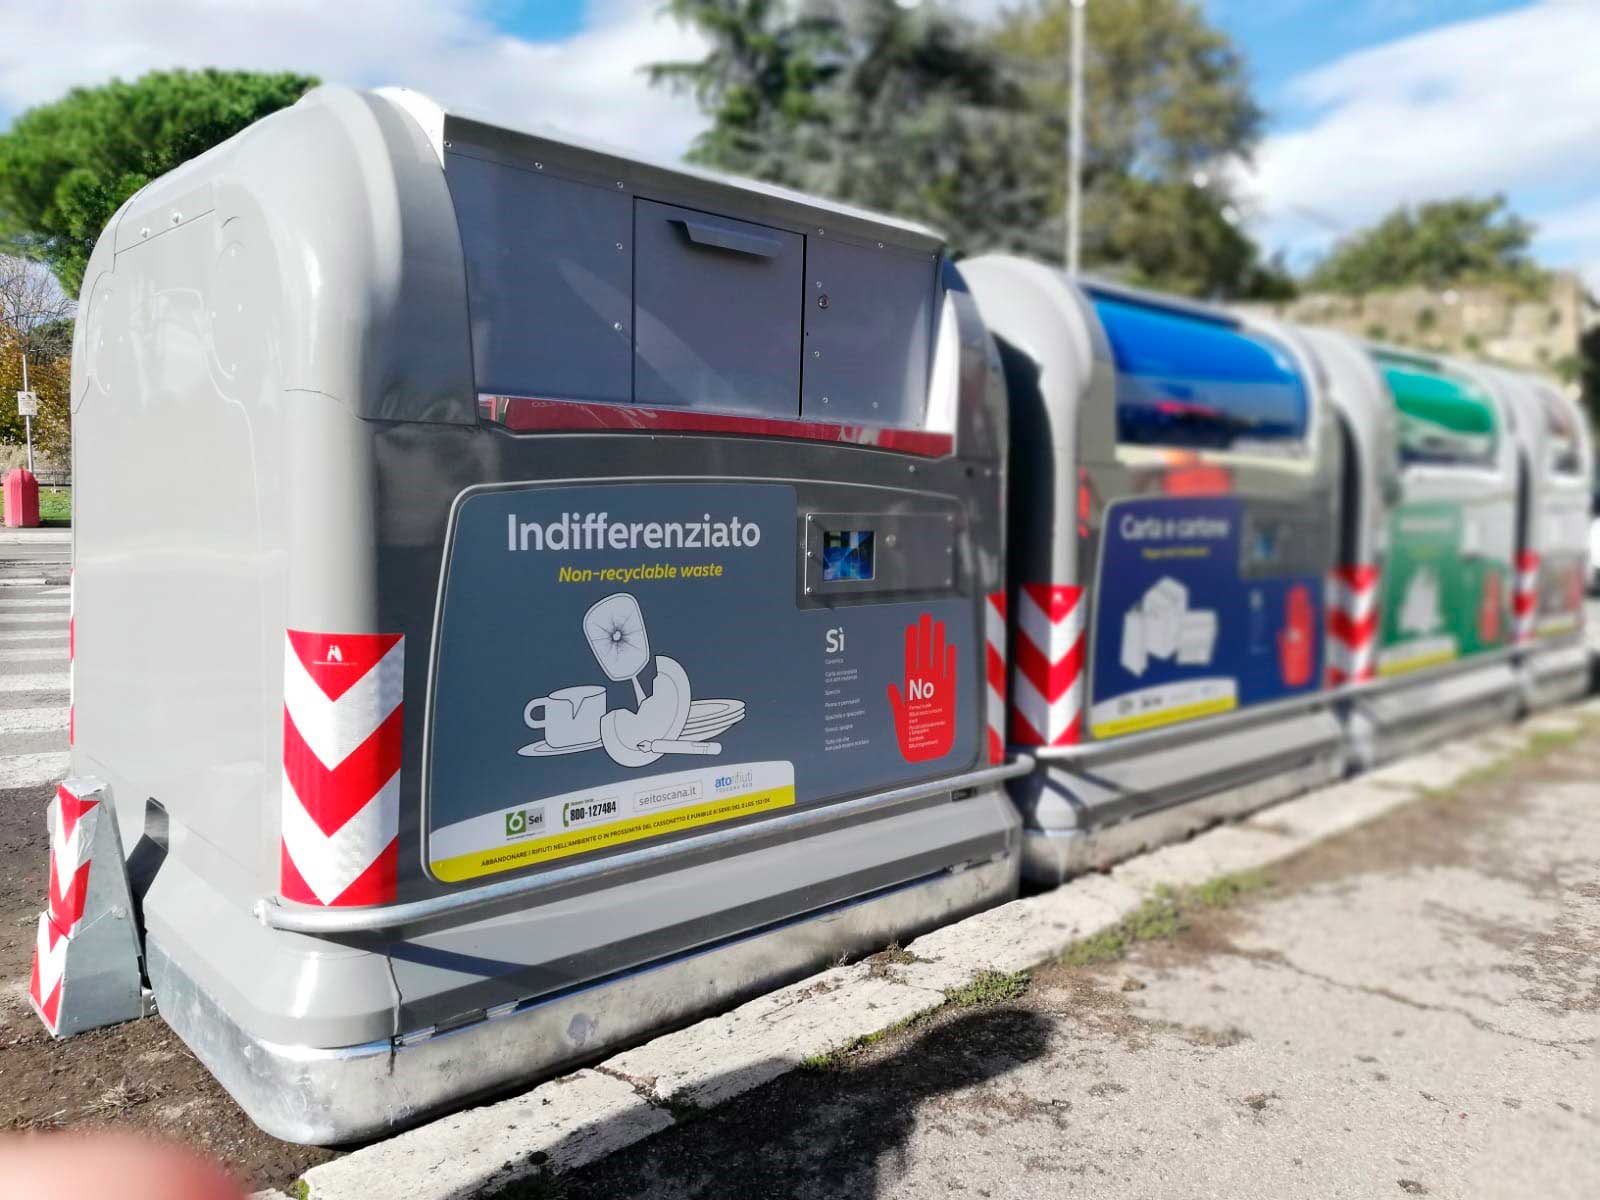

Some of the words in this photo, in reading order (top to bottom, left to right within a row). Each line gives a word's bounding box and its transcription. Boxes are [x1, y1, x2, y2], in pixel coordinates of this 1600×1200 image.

[507, 512, 761, 552] Indifferenziato
[558, 564, 677, 583] Non-recyclable
[680, 563, 723, 577] waste
[825, 627, 845, 653] Sì
[909, 678, 934, 700] No
[639, 785, 697, 806] seitoscana.it
[528, 814, 543, 825] Sei
[570, 801, 617, 821] 800-127484
[481, 851, 527, 866] ABBANDONARE
[532, 845, 553, 856] RIFIUTI
